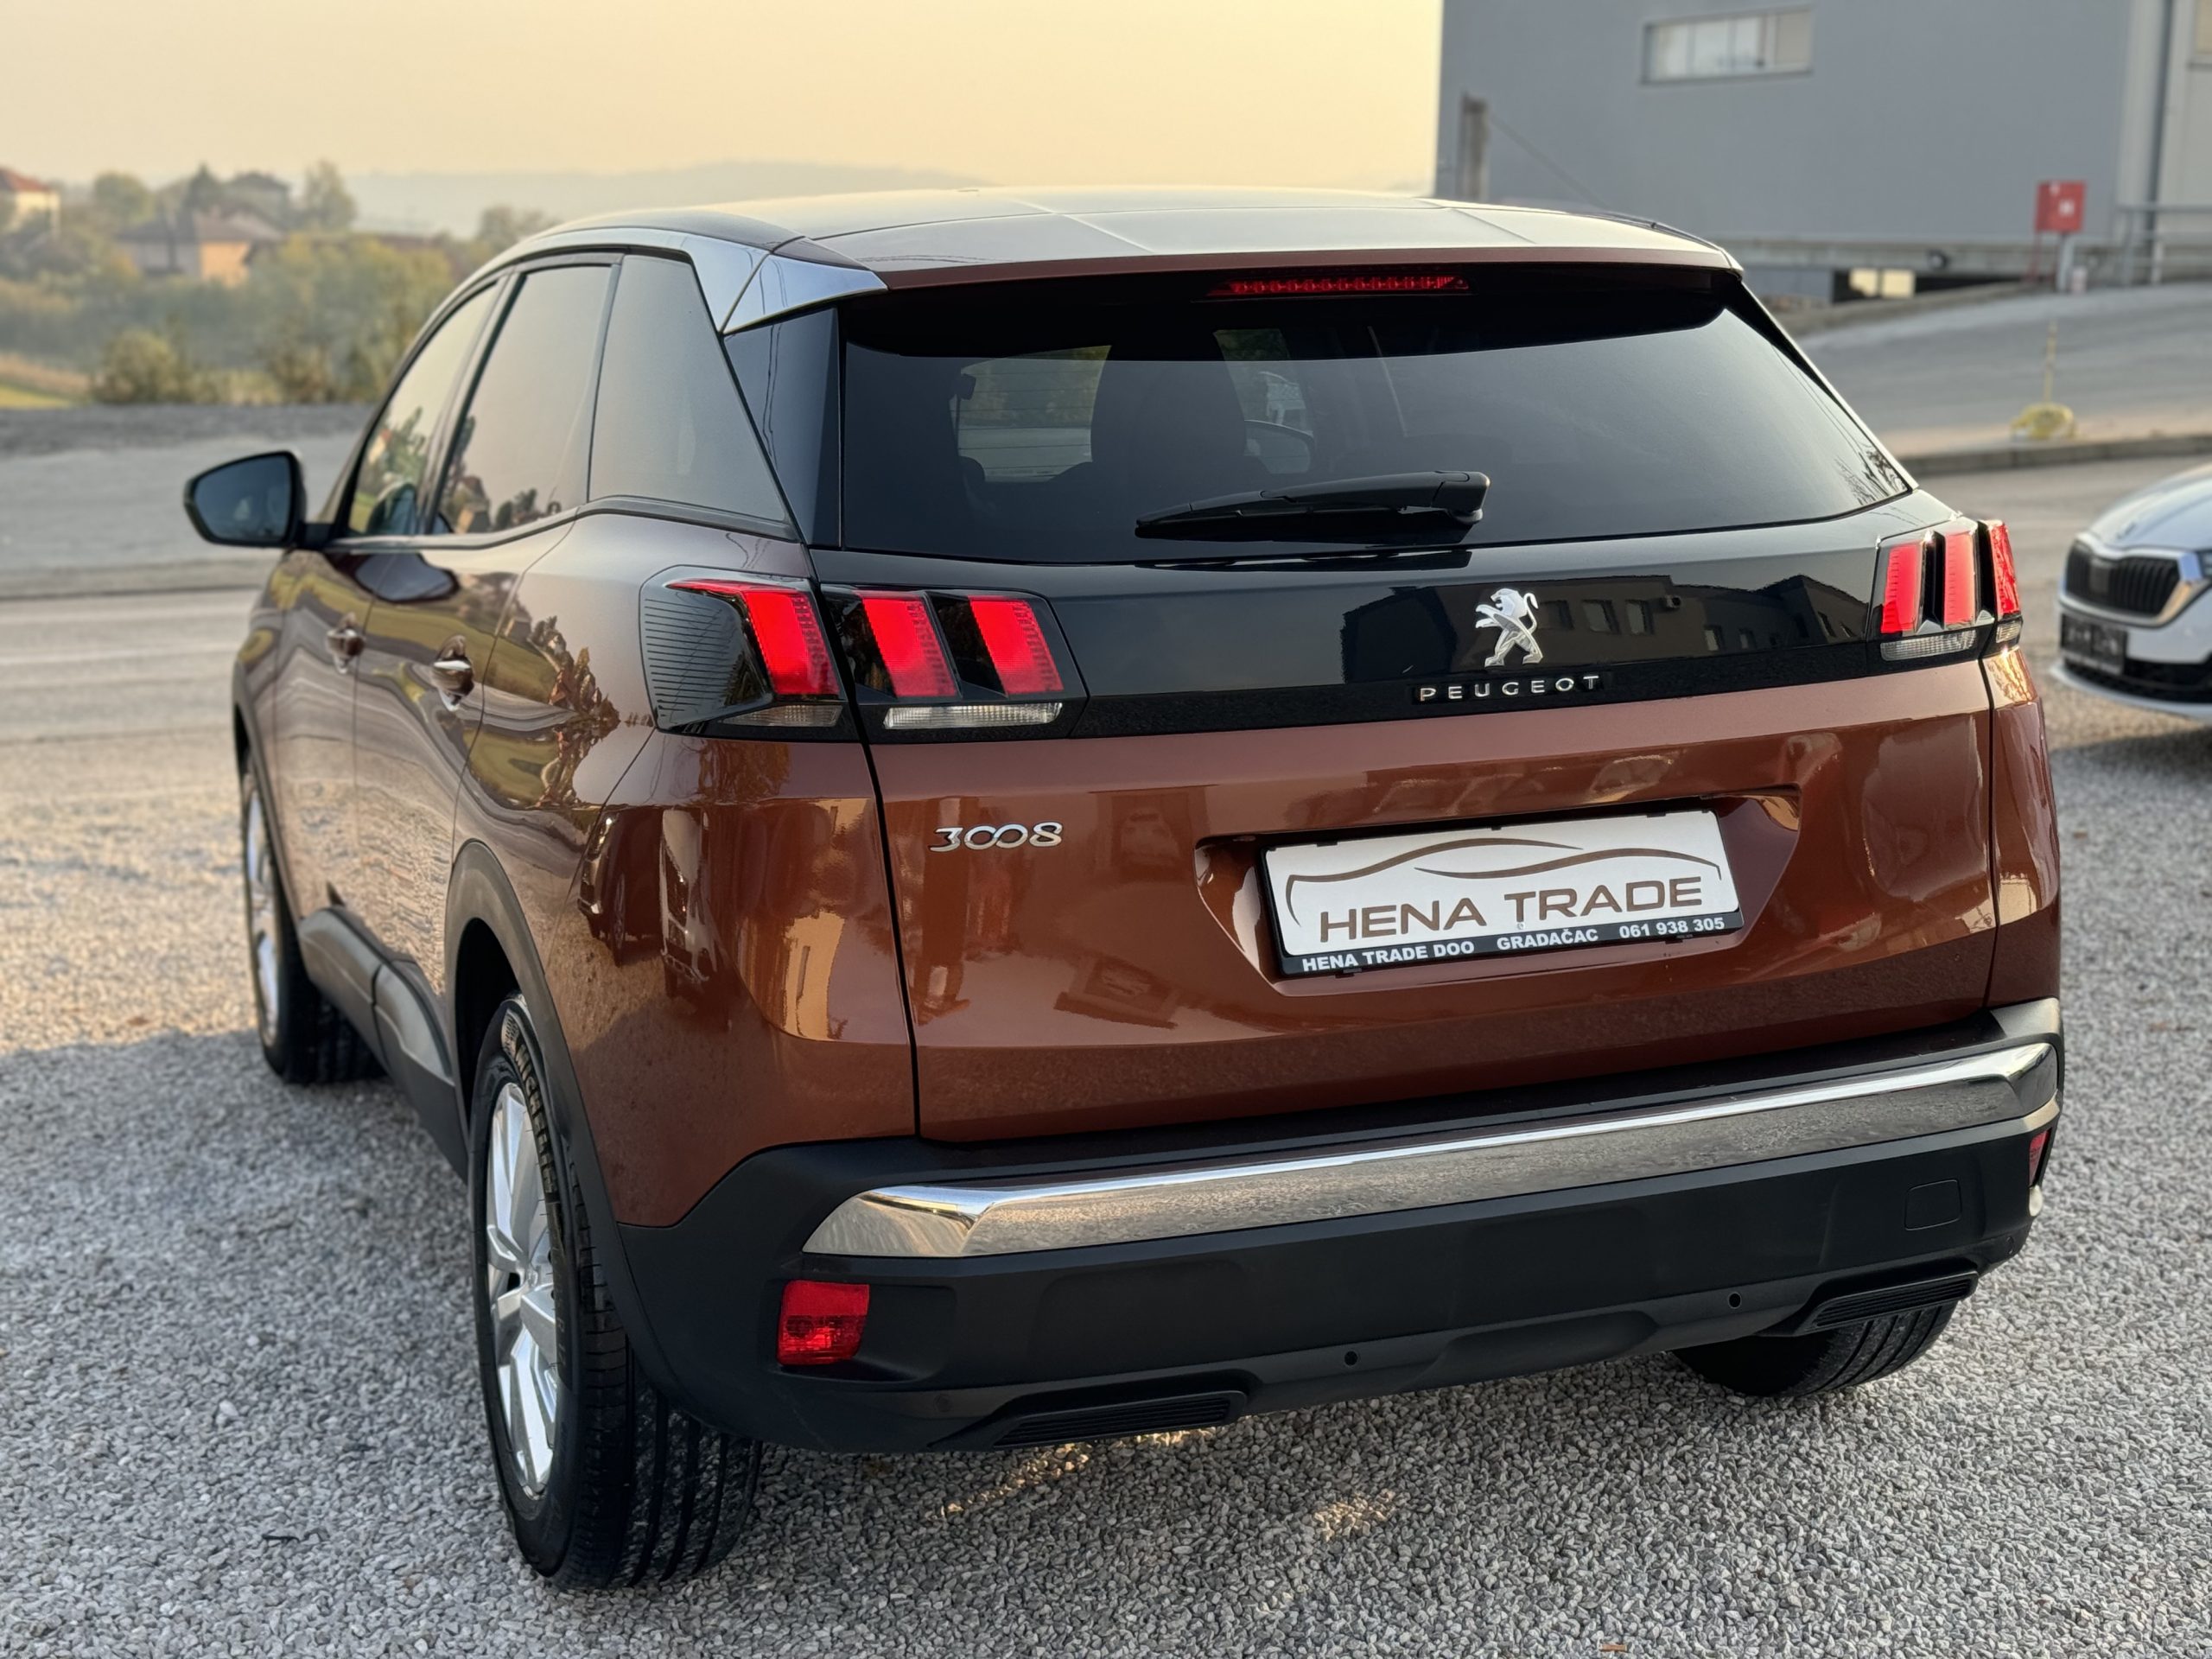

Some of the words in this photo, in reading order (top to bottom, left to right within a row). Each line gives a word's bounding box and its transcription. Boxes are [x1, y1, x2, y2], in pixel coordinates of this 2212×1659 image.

[1420, 675, 1599, 702] PEUGEOT
[930, 822, 1063, 853] 3008
[1319, 898, 1487, 943] HENA
[1503, 875, 1703, 923] TRADE
[1302, 954, 1358, 972] HENA
[1362, 946, 1428, 965] TRADE
[1433, 940, 1475, 957] DOO
[1497, 927, 1599, 950] GRADAČAC
[1619, 924, 1650, 939] 061
[1656, 919, 1689, 936] 938
[1693, 917, 1725, 932] 305
[515, 1043, 559, 1194] MICHELIN
